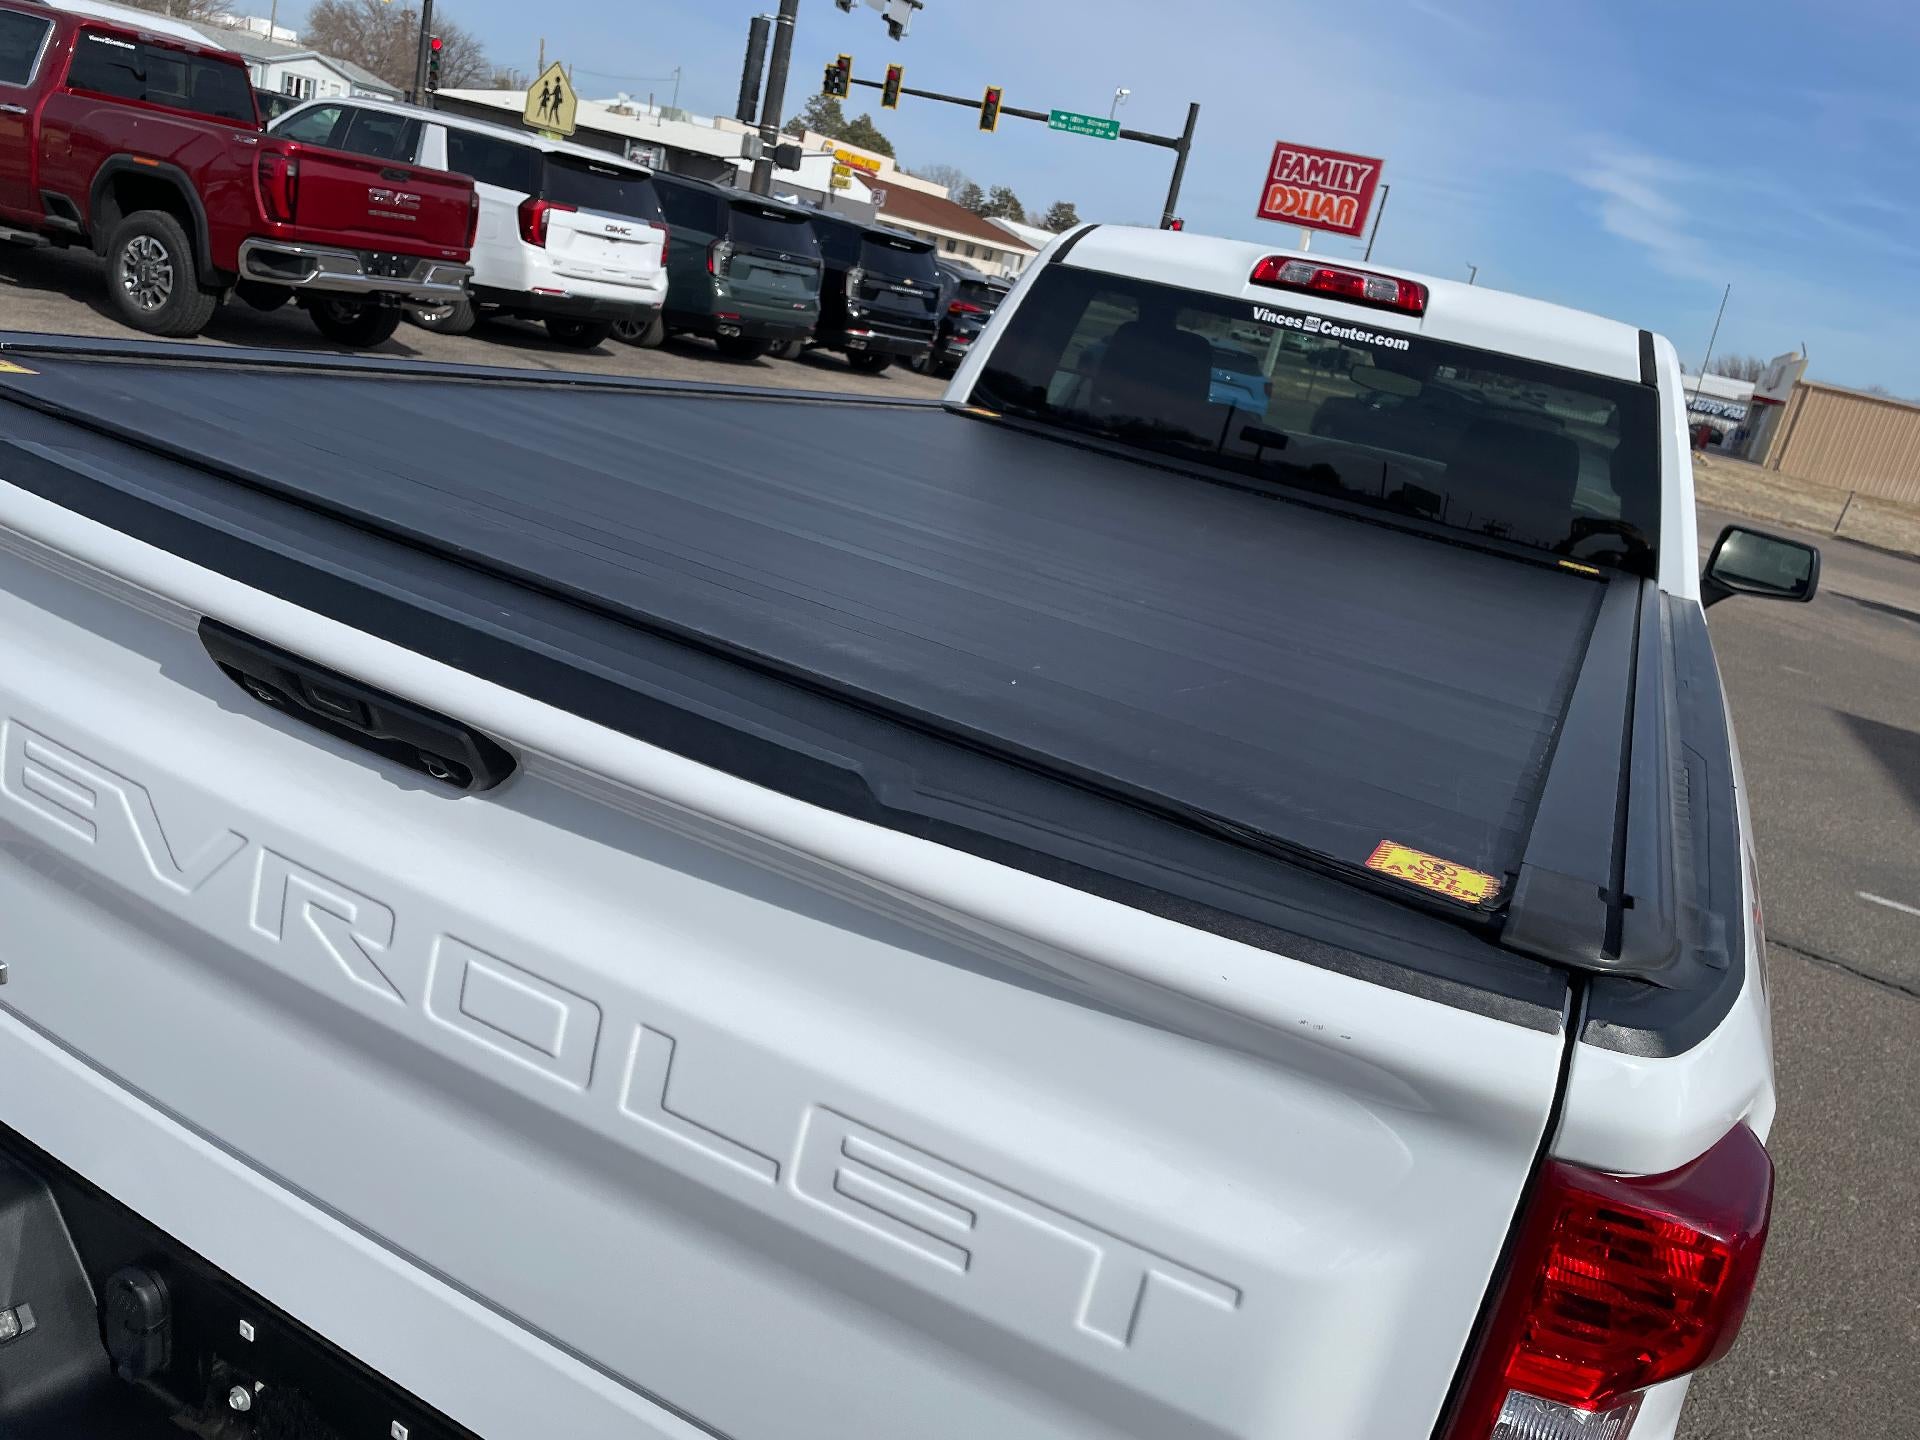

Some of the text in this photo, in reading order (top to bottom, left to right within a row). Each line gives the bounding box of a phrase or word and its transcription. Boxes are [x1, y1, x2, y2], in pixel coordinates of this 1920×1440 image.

[1087, 118, 1110, 129] Street
[1273, 149, 1374, 195] FAMILY
[1263, 182, 1360, 229] DOLLAR
[604, 223, 632, 237] GMC
[1252, 306, 1303, 329] Vinces
[1319, 321, 1410, 351] Center.com
[2, 717, 1243, 1348] EVROLET
